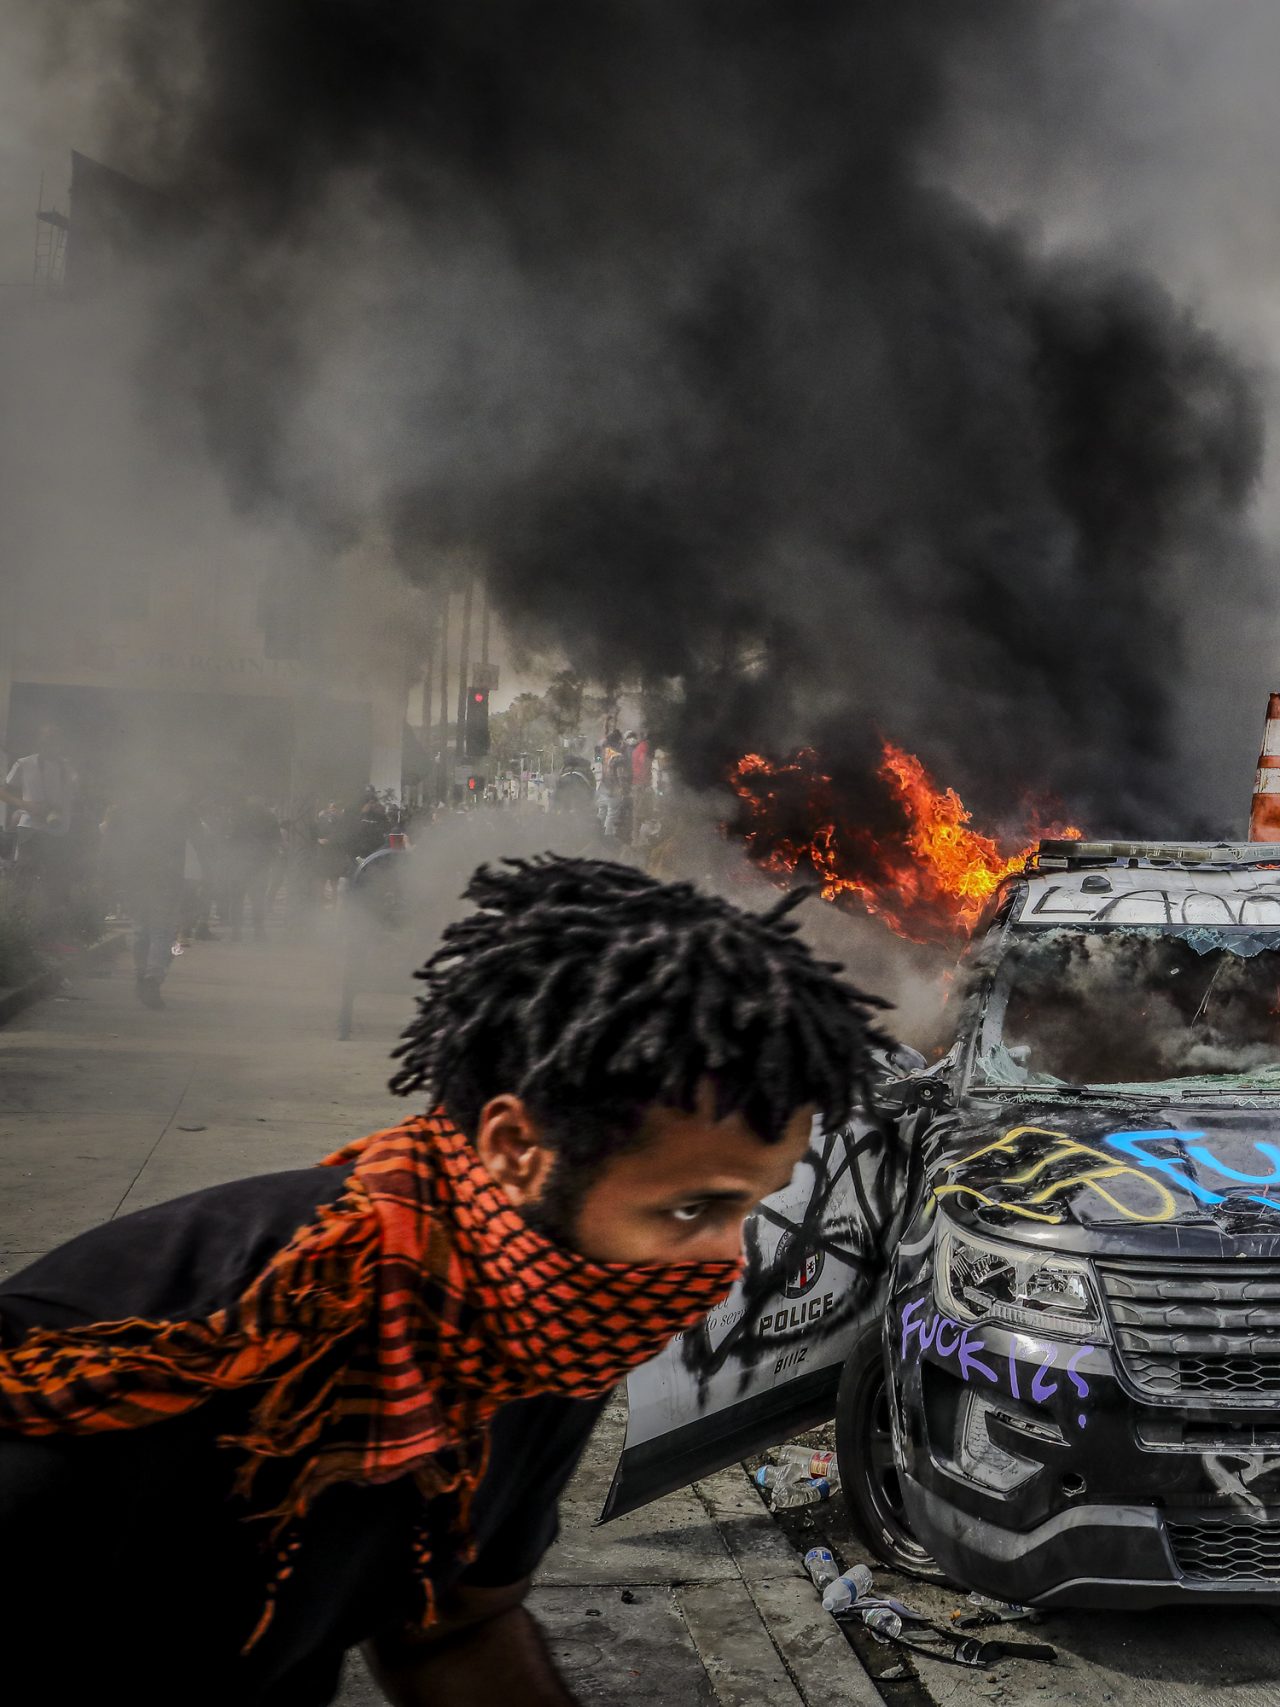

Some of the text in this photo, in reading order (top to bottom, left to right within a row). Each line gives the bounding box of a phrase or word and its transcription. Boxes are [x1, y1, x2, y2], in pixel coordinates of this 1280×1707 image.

[759, 1291, 834, 1337] POLICE
[774, 1347, 809, 1375] 81112
[902, 1298, 998, 1382] FUCK
